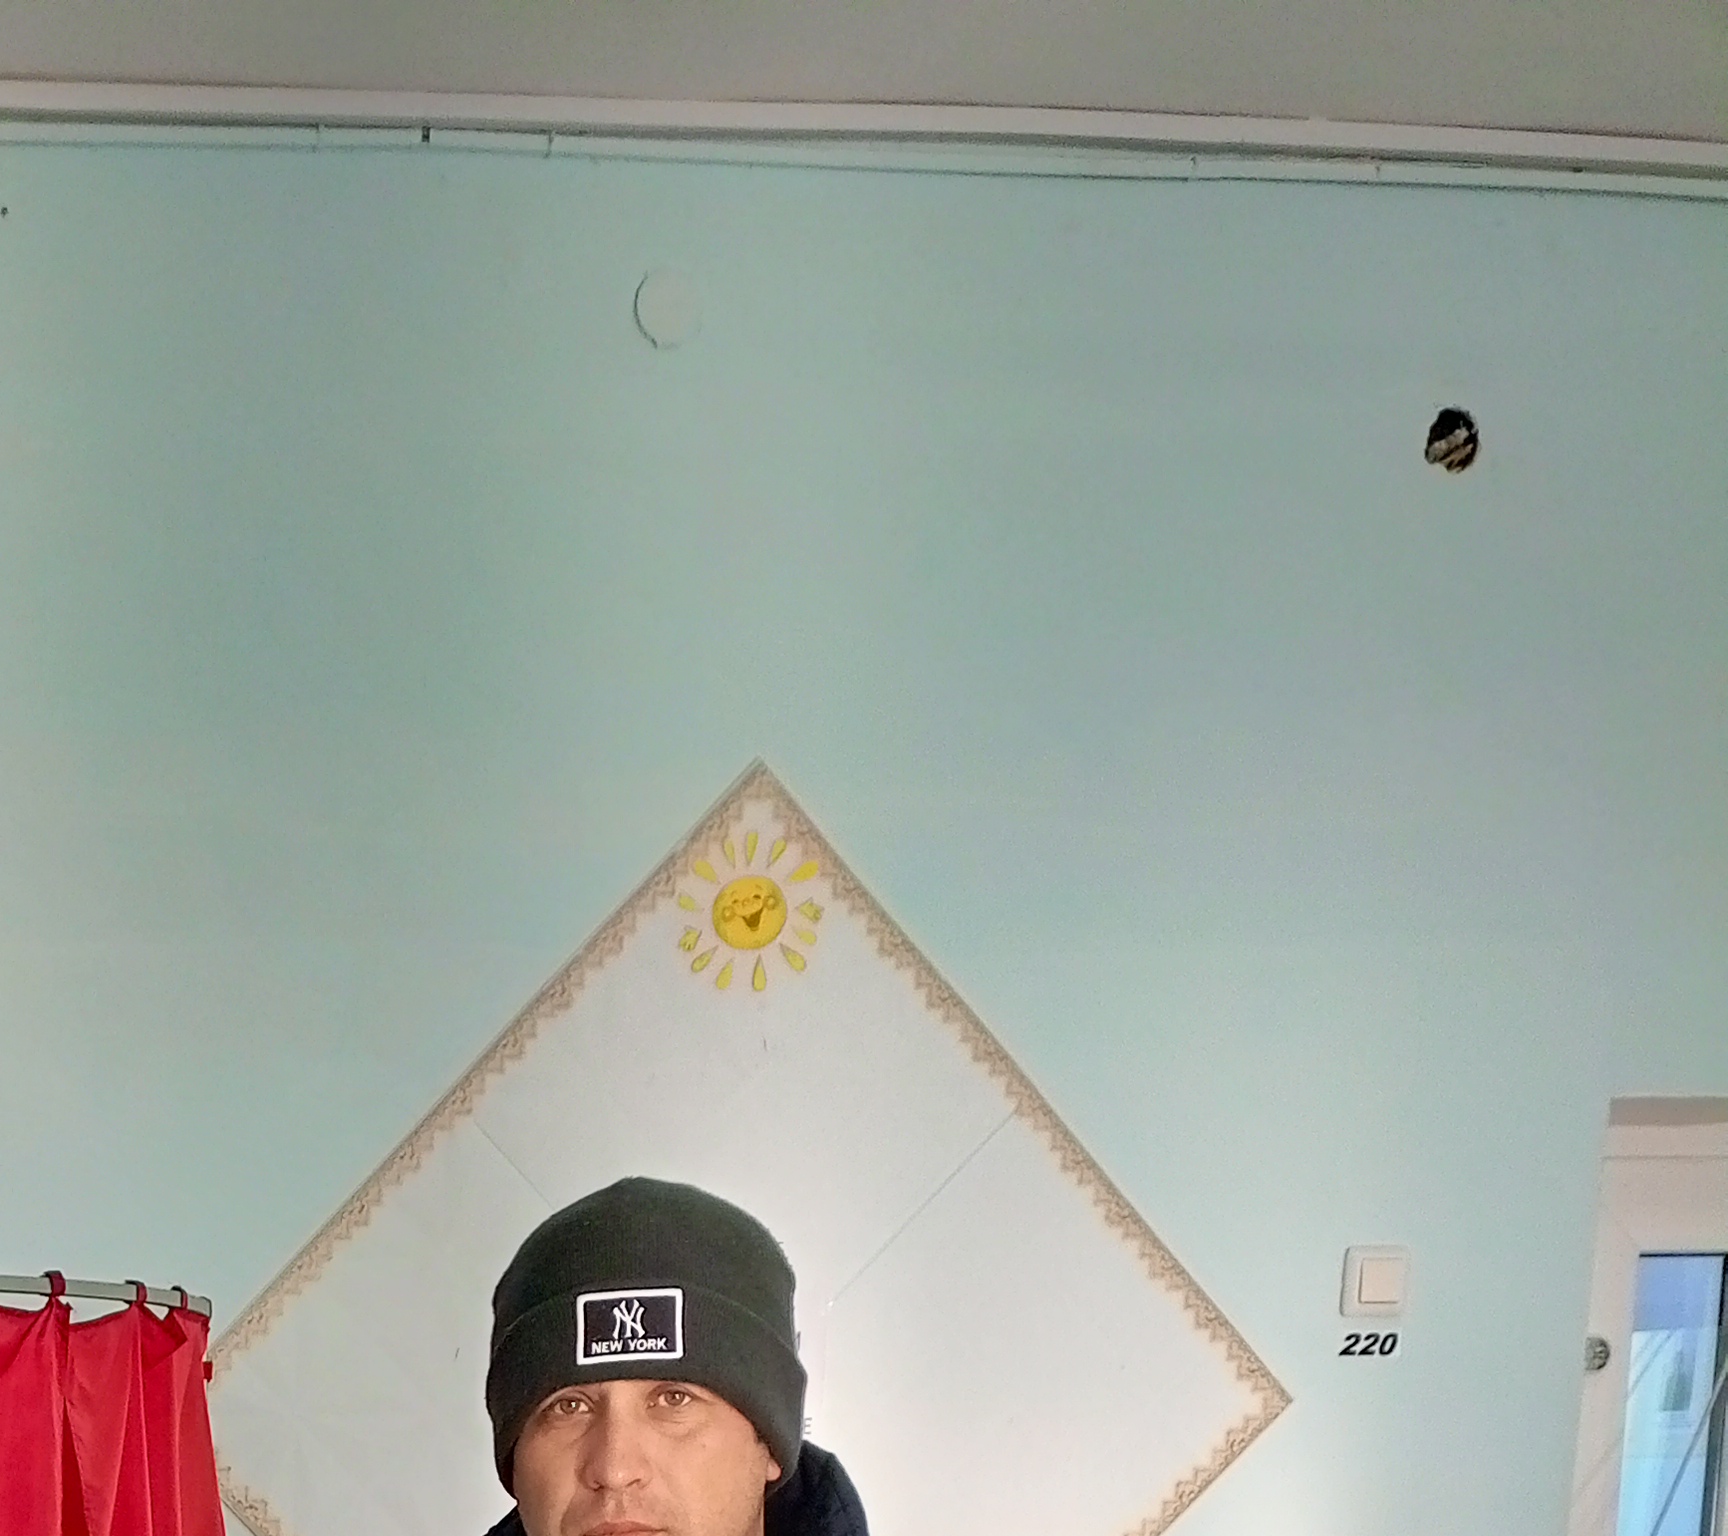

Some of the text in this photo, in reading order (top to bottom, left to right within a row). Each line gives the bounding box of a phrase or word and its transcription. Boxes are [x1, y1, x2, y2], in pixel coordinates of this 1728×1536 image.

[591, 1337, 668, 1355] NEW YORK
[1338, 1332, 1399, 1357] 220
